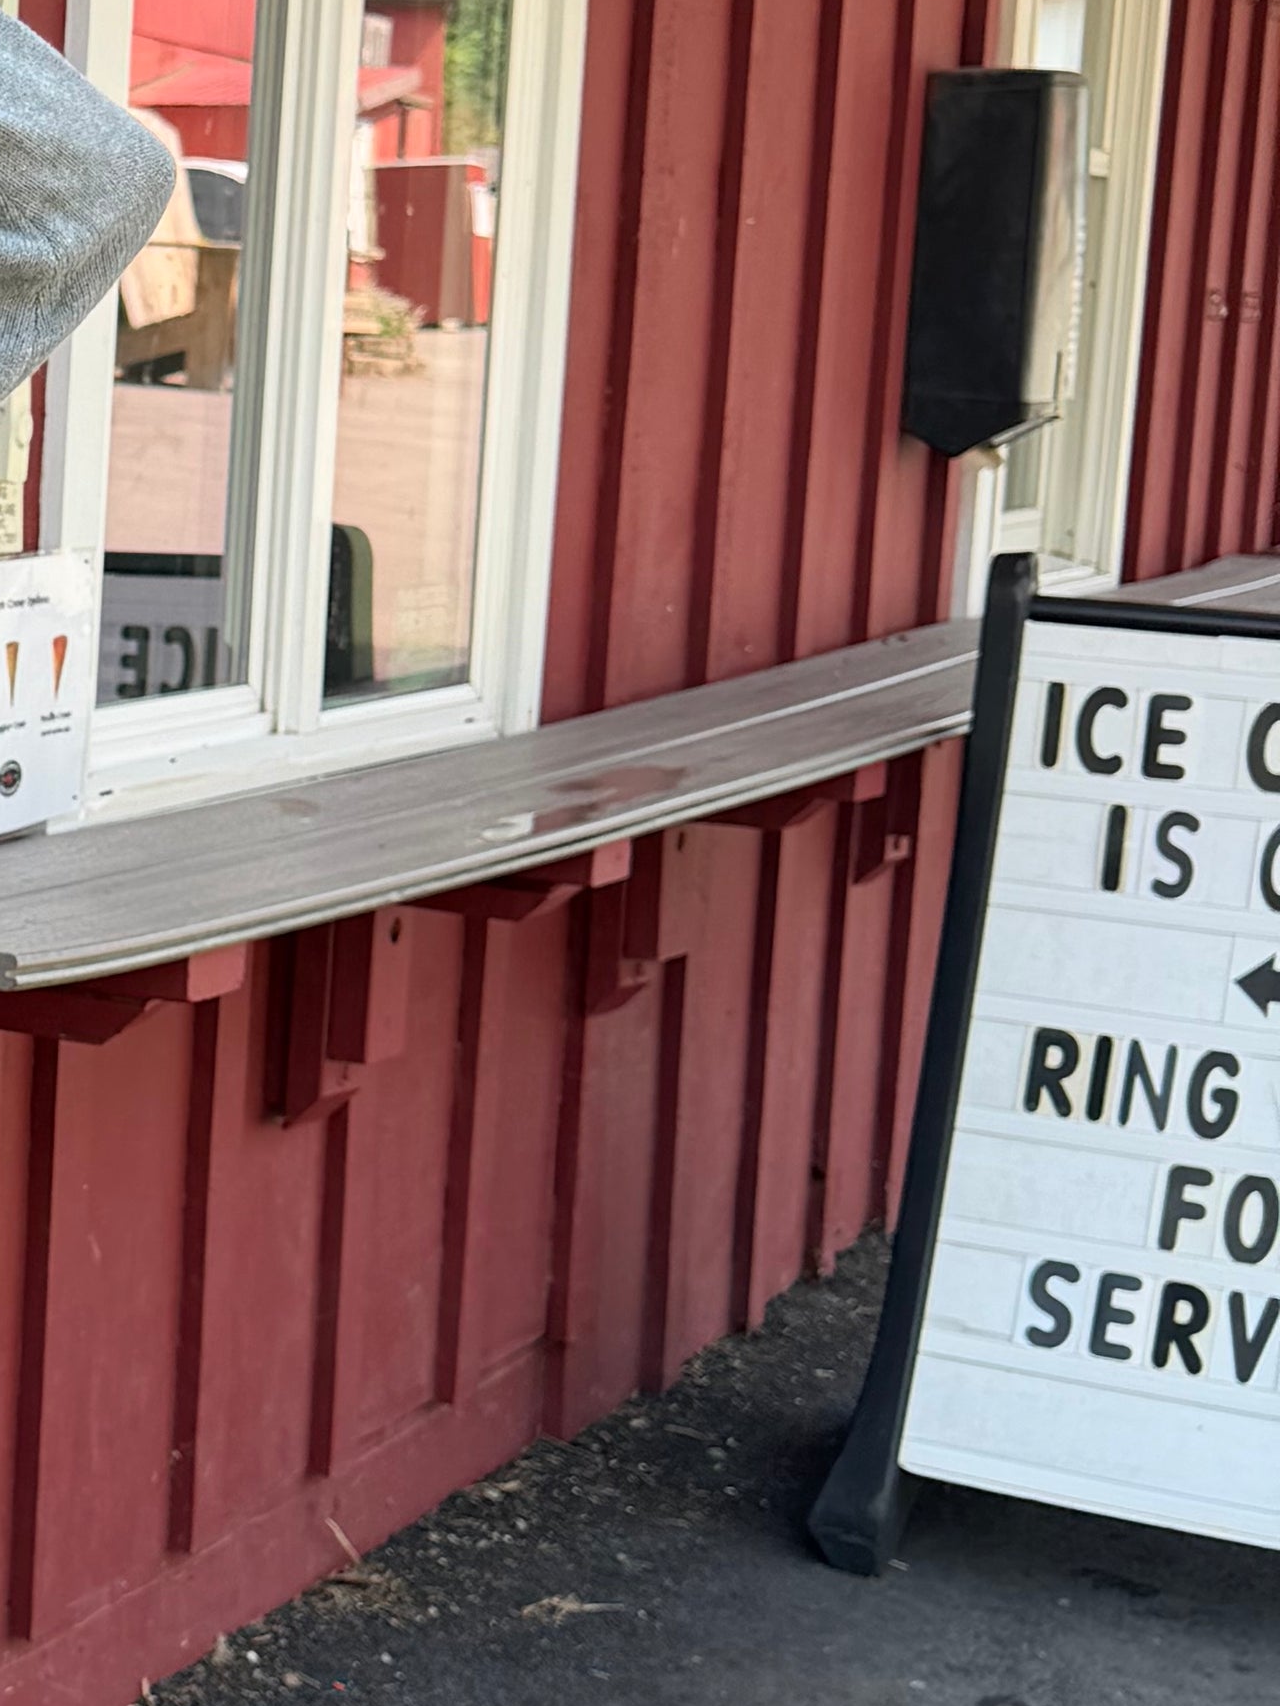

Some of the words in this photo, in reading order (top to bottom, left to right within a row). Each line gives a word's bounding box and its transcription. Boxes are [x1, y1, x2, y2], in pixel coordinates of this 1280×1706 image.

[1042, 681, 1193, 780] ICE
[1102, 804, 1200, 899] IS
[1024, 1026, 1240, 1140] RING
